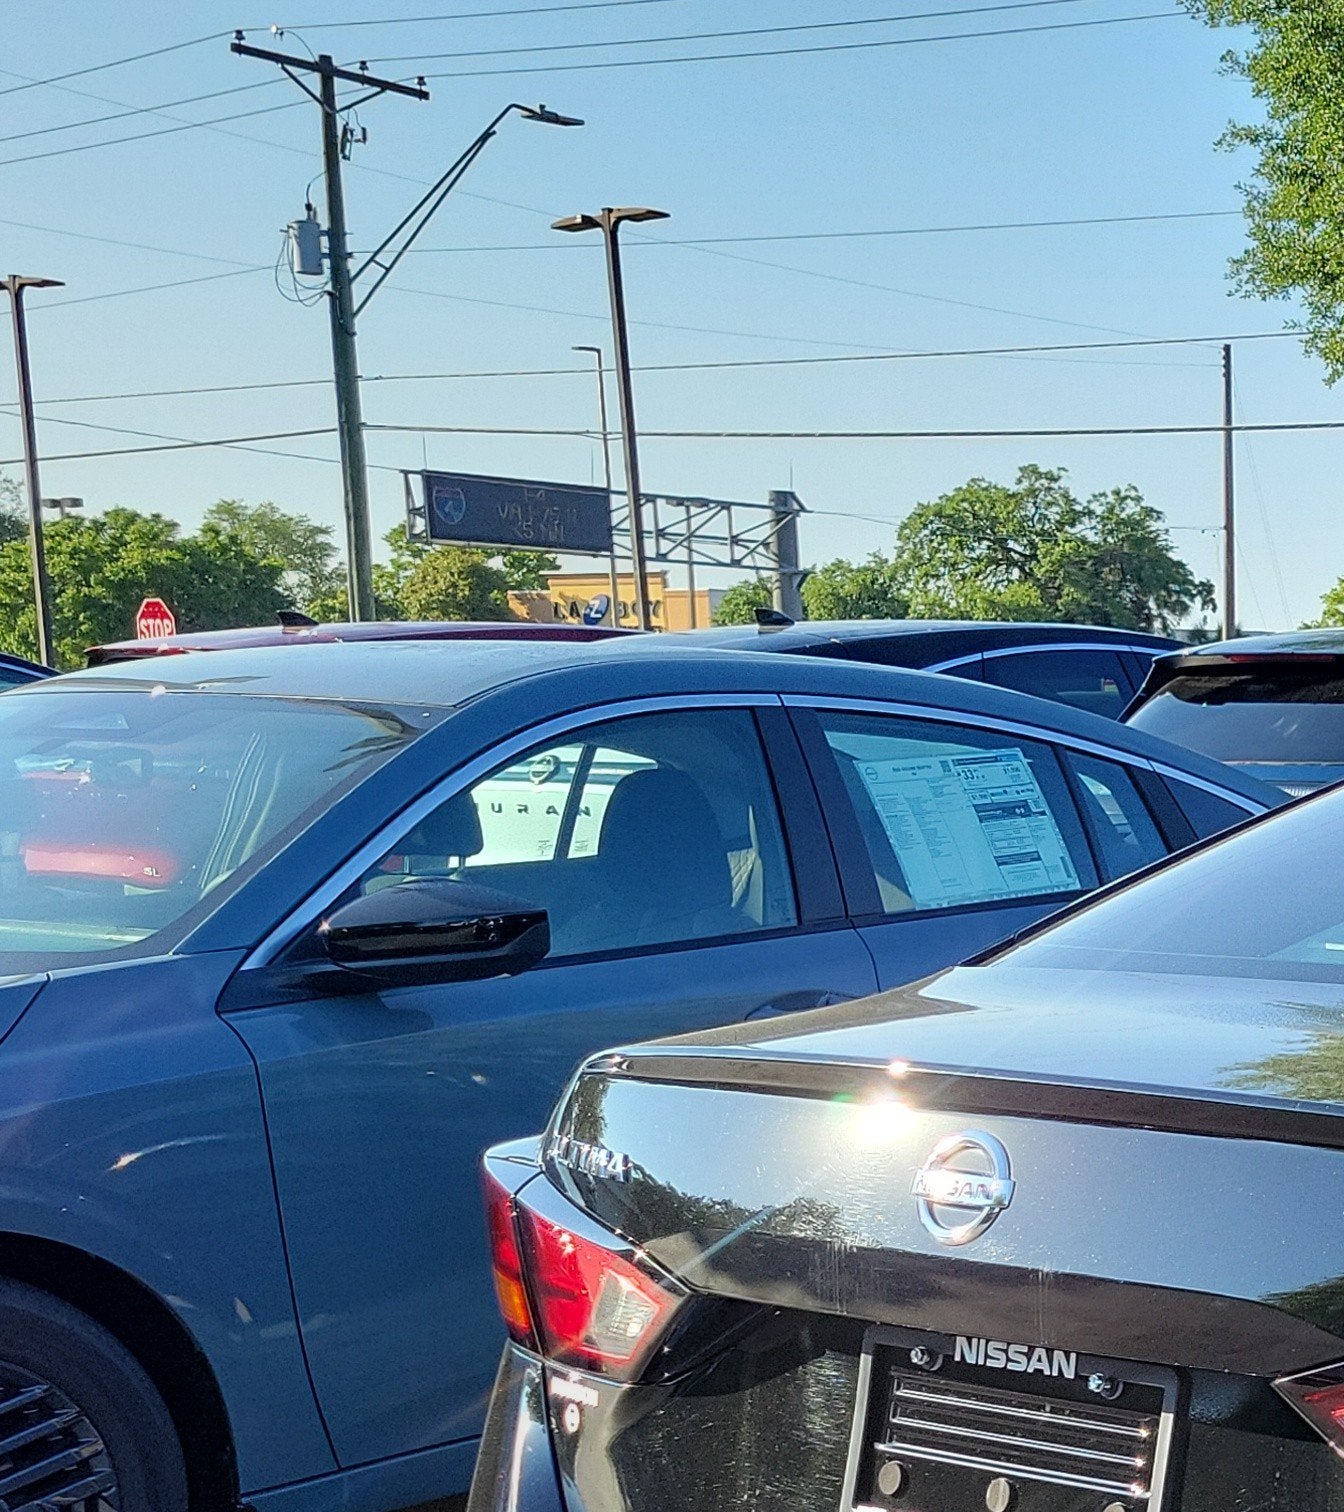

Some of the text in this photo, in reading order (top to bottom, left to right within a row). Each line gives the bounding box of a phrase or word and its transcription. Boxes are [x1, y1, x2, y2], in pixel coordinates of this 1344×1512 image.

[139, 618, 173, 640] STOP
[474, 802, 592, 817] URAN
[953, 1335, 1077, 1380] NISSAN
